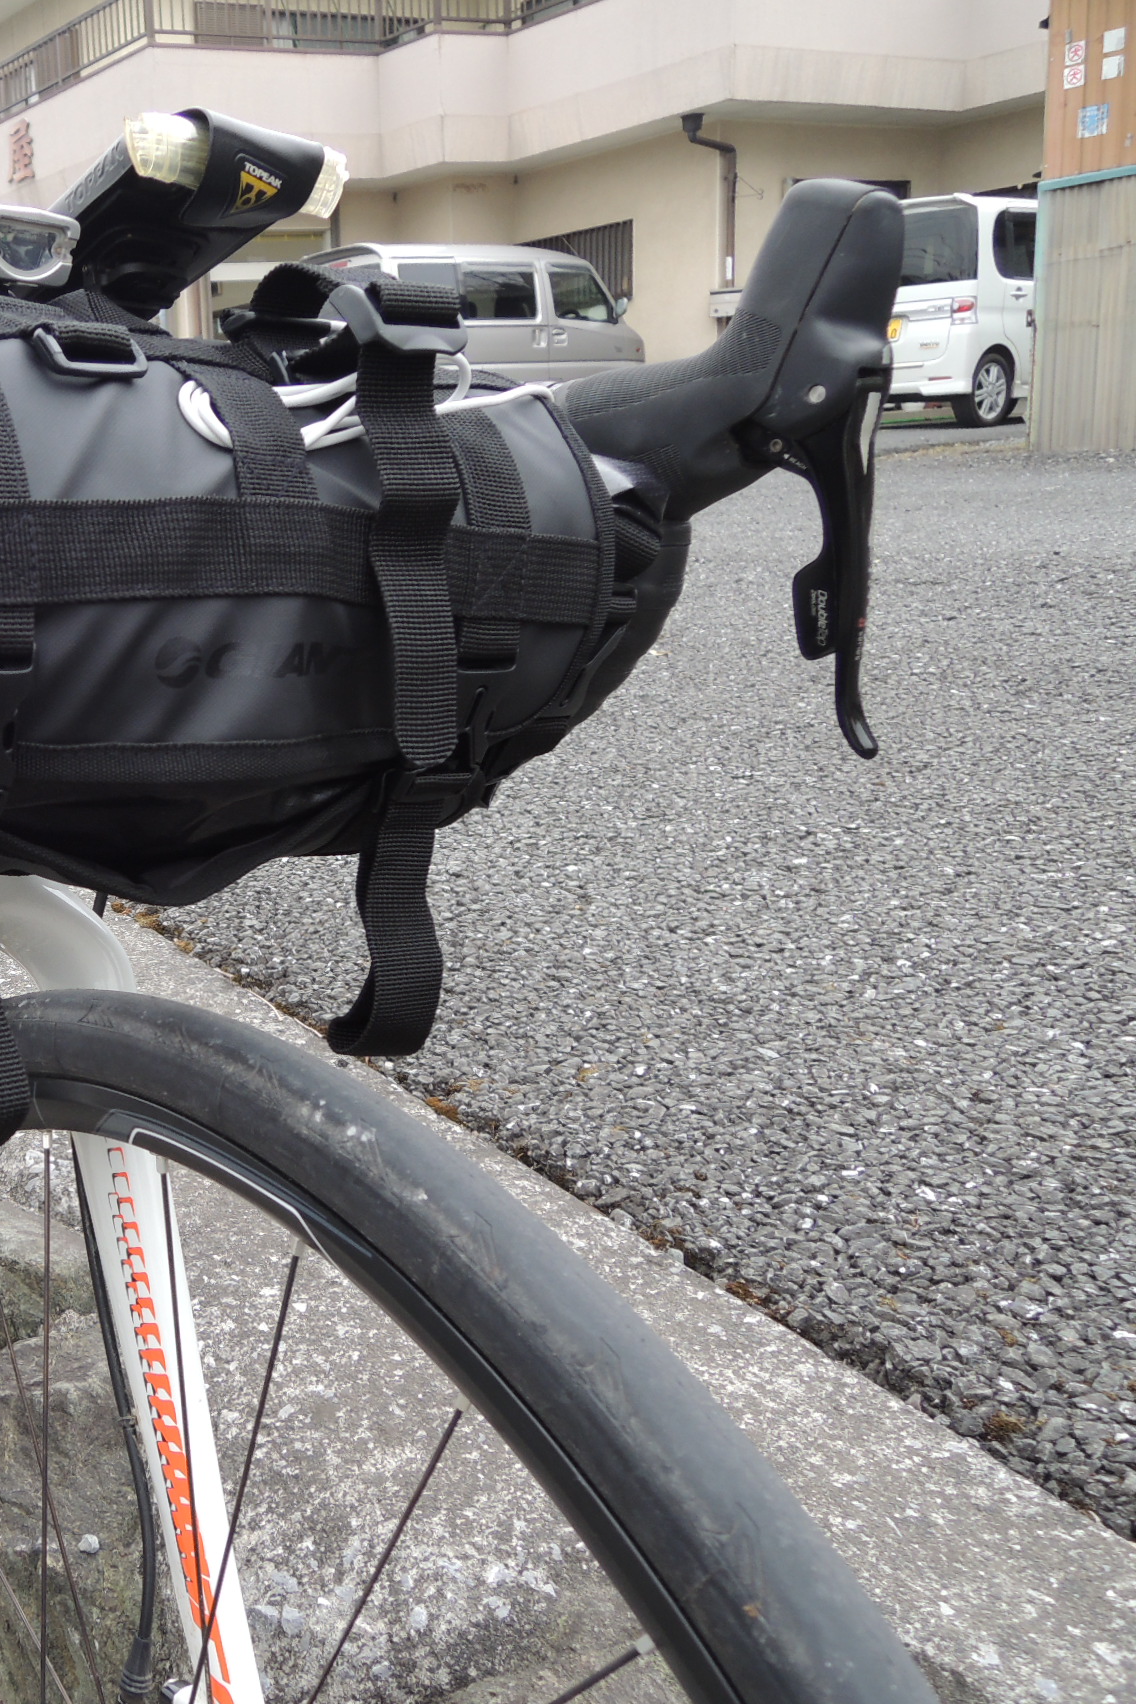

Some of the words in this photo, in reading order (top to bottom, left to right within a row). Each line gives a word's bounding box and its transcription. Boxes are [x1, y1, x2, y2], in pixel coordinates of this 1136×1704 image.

[65, 141, 124, 212] TOPEAK
[244, 160, 283, 190] TOPEAK
[205, 641, 361, 679] GANT
